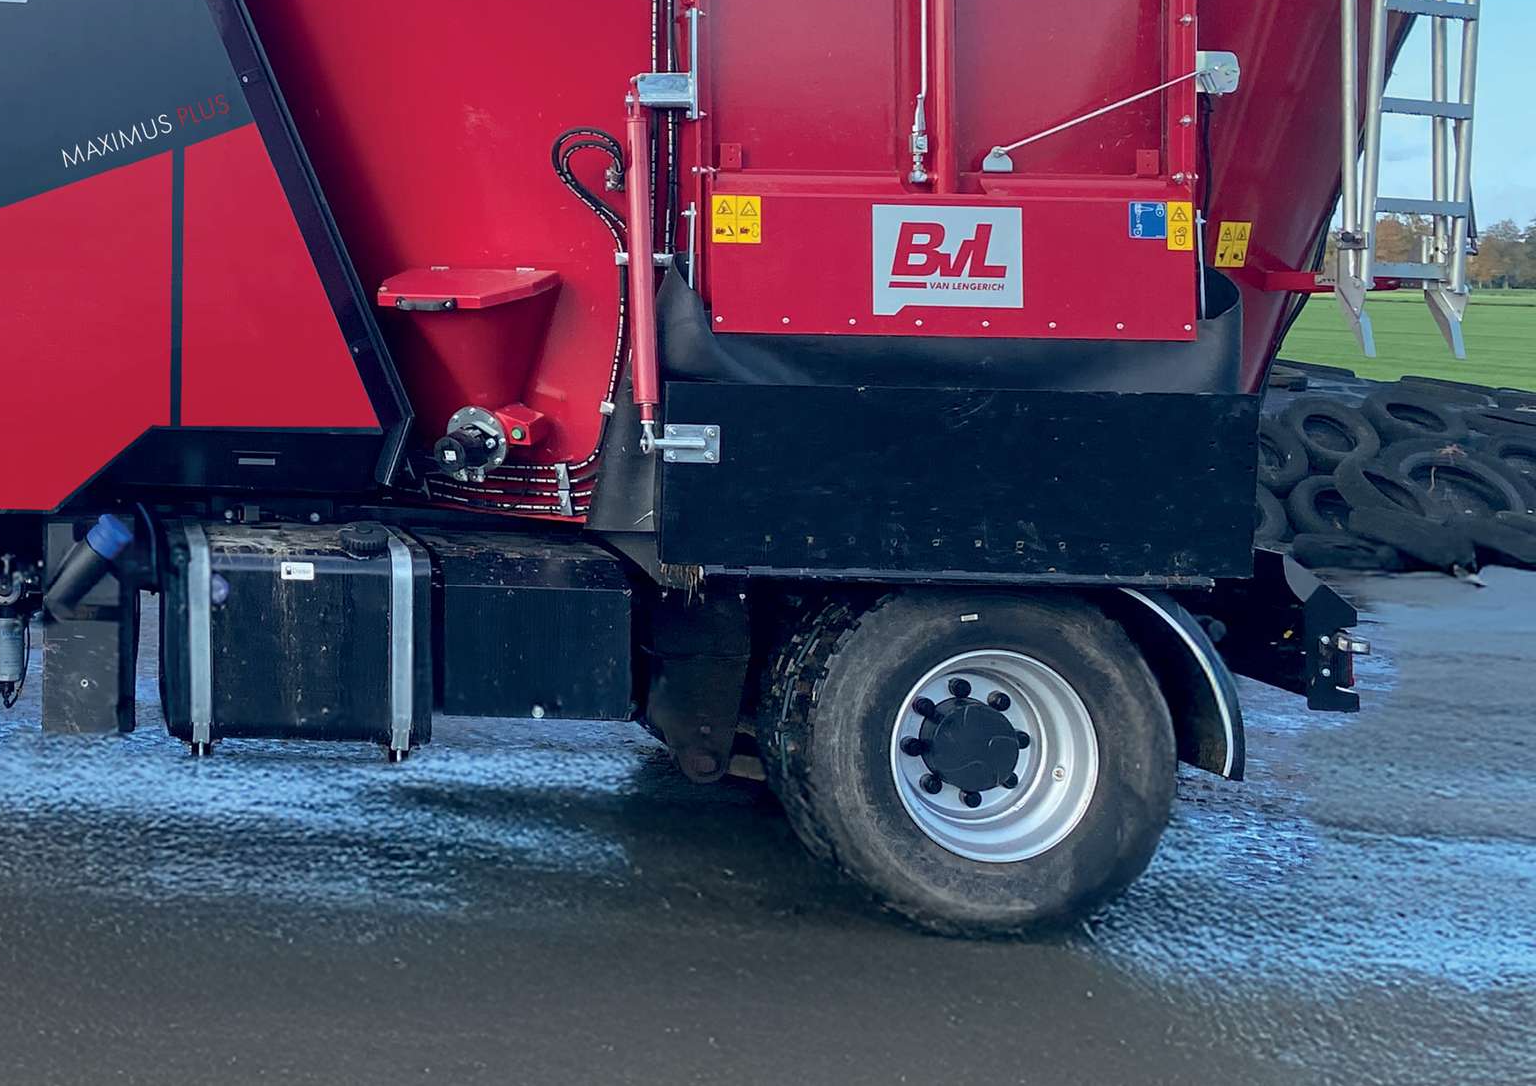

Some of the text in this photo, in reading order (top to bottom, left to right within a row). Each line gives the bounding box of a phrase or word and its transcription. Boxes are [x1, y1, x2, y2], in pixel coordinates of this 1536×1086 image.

[61, 93, 230, 168] MAXIMUS PLUS
[929, 282, 1005, 291] VAN LENGERICH
